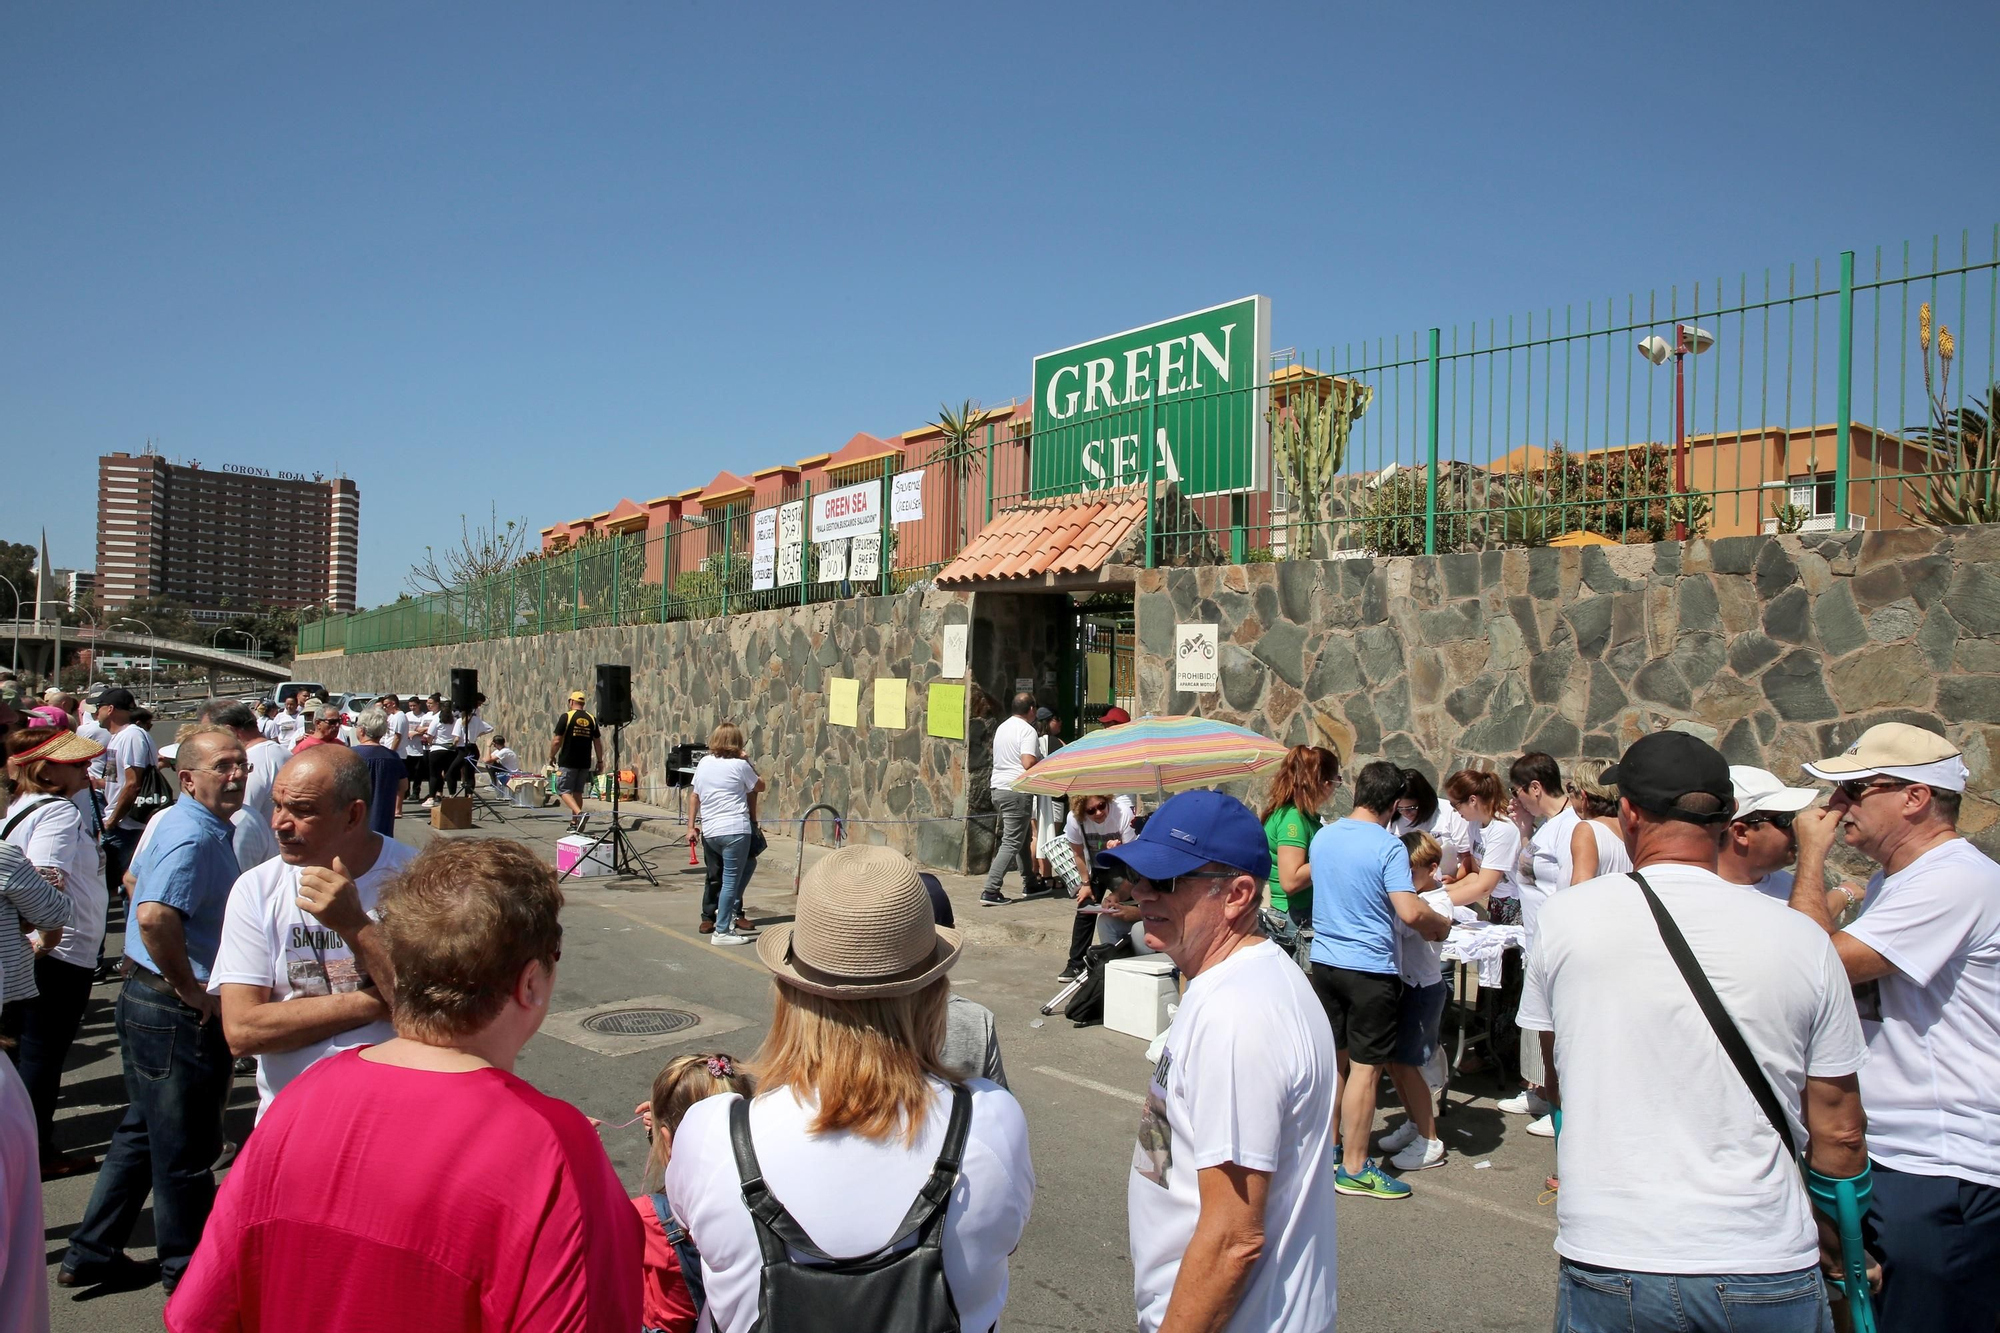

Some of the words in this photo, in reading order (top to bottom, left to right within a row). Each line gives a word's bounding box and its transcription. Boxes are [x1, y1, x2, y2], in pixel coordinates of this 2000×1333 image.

[1046, 323, 1237, 420] GREEN
[1081, 427, 1184, 493] SEA
[222, 463, 270, 477] CORONA
[278, 470, 305, 481] ROJA
[825, 495, 850, 519] GREEN
[852, 491, 867, 513] SEA
[855, 564, 869, 576] SEA
[1177, 672, 1217, 680] PROHIBIDO
[1287, 823, 1298, 838] 3
